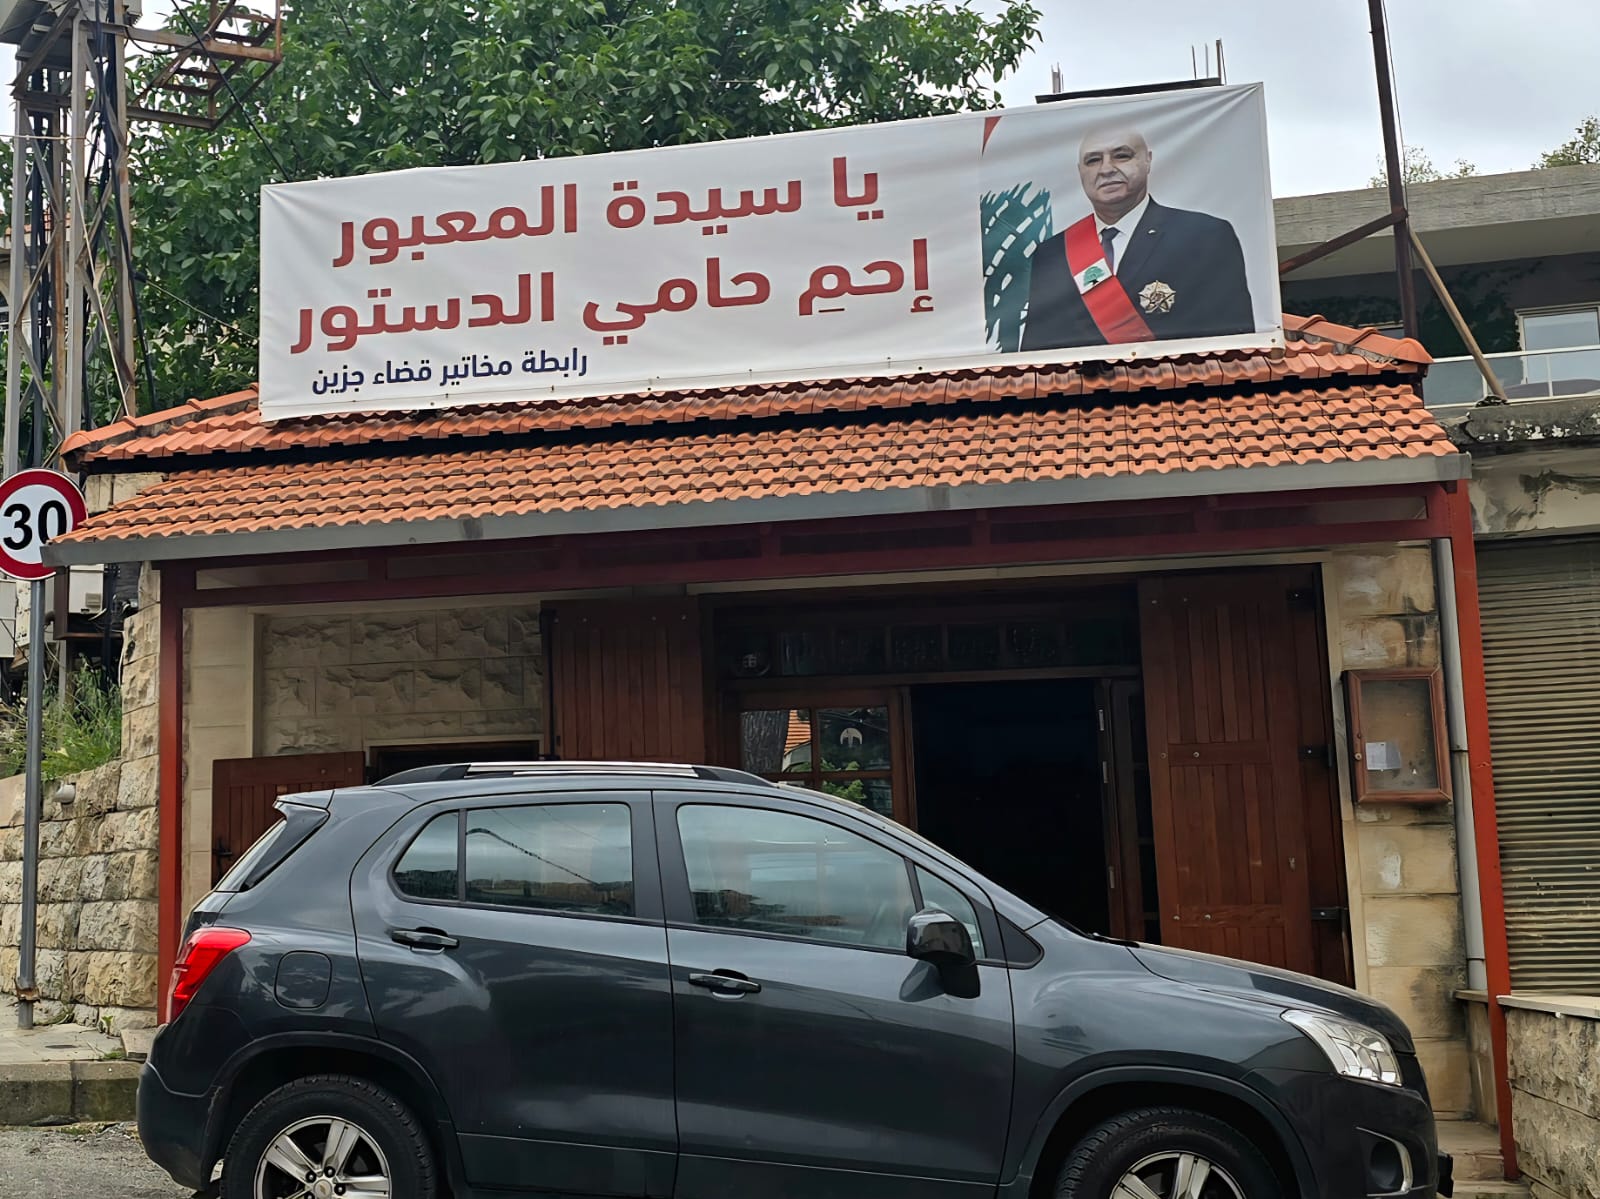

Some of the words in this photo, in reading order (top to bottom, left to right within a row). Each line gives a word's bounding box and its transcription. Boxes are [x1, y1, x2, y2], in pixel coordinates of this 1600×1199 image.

[606, 180, 802, 236] سيدة
[834, 157, 883, 221] يا
[333, 183, 578, 267] المعبور
[291, 272, 555, 353] الدستور
[583, 257, 771, 345] حامي
[312, 364, 365, 395] جزين
[372, 360, 432, 385] قضاء
[439, 354, 513, 386] مخاتير
[521, 347, 588, 377] رابطة
[3, 500, 67, 550] 30
